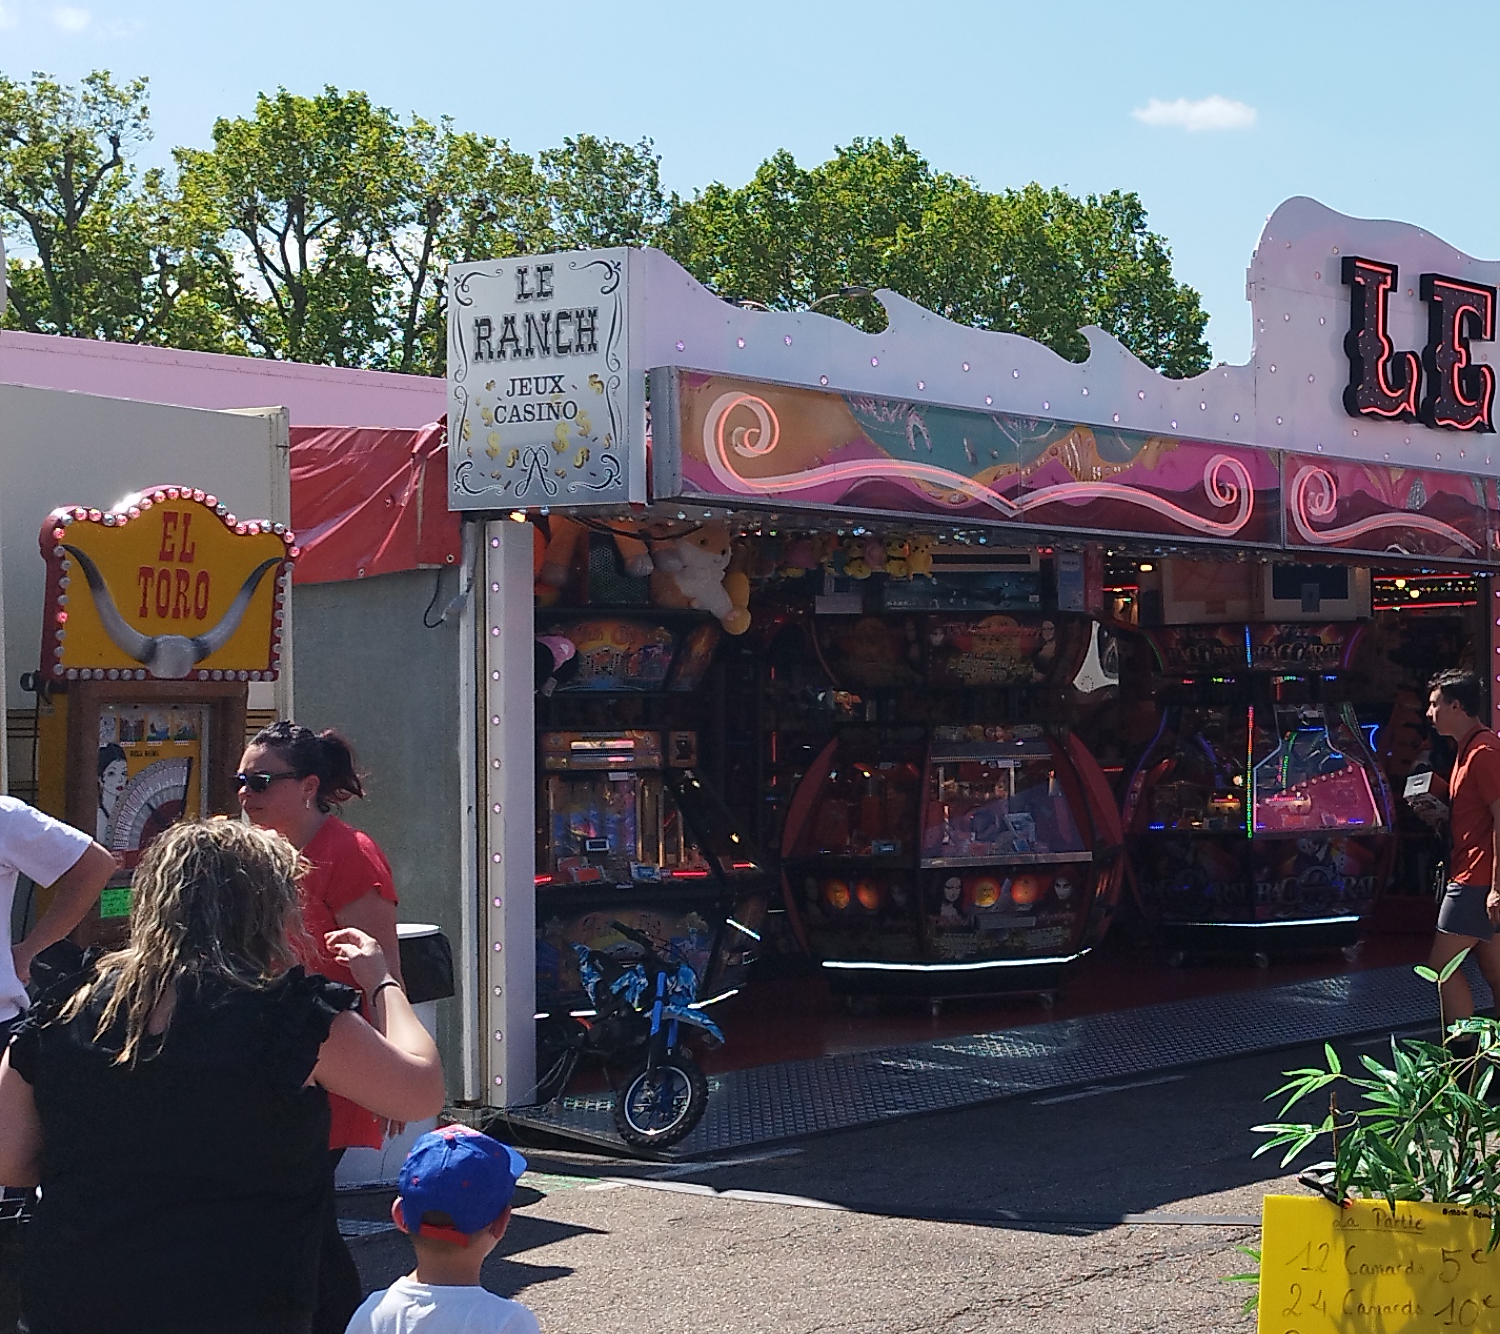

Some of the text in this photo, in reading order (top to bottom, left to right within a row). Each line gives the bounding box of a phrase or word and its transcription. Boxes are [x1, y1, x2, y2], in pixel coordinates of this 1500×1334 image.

[516, 264, 554, 302] LE
[473, 307, 599, 363] RANCH
[1341, 255, 1498, 434] LE
[506, 375, 566, 397] JEUX
[494, 401, 578, 424] CASINO
[159, 511, 196, 563] EL
[138, 566, 210, 620] TORO
[1372, 1207, 1426, 1231] Partie
[1285, 1241, 1330, 1272] 12
[1282, 1283, 1327, 1317] 24
